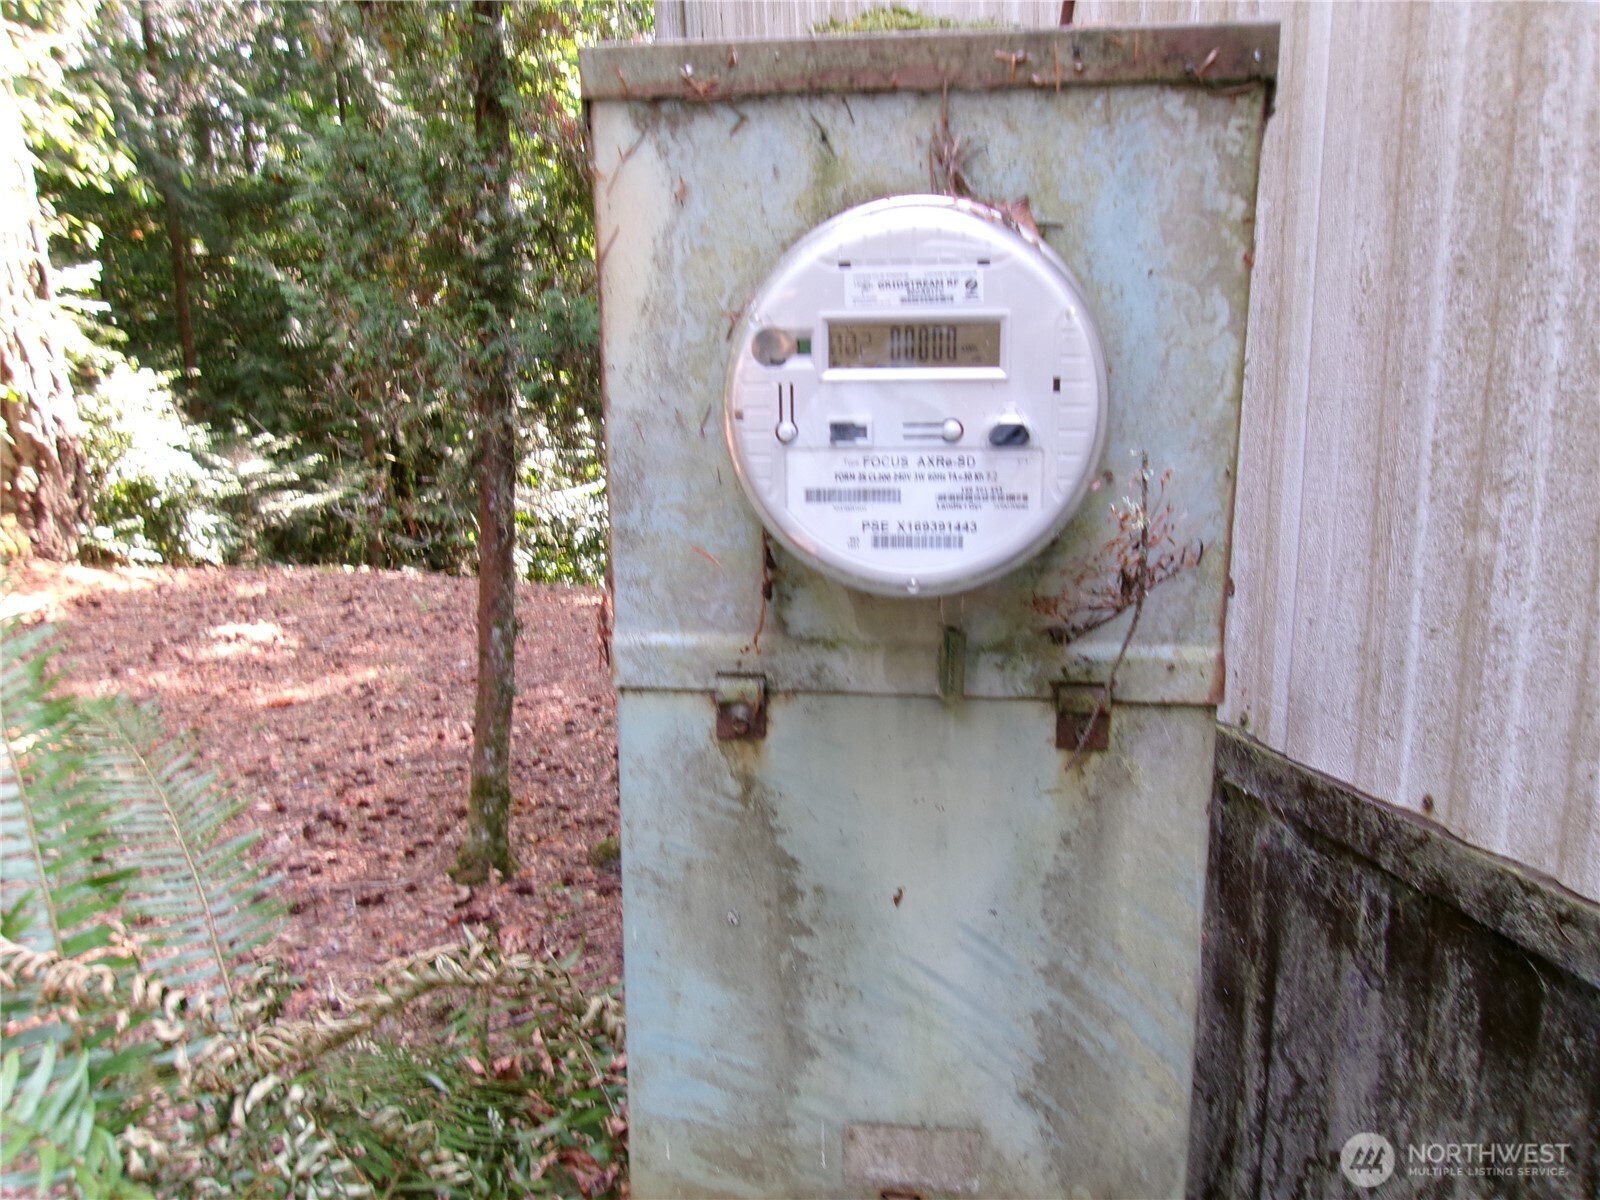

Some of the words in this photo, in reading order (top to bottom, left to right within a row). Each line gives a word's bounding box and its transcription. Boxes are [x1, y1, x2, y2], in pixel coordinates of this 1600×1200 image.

[890, 325, 957, 361] 00000
[863, 456, 909, 469] FOCUS
[862, 521, 889, 533] PSE
